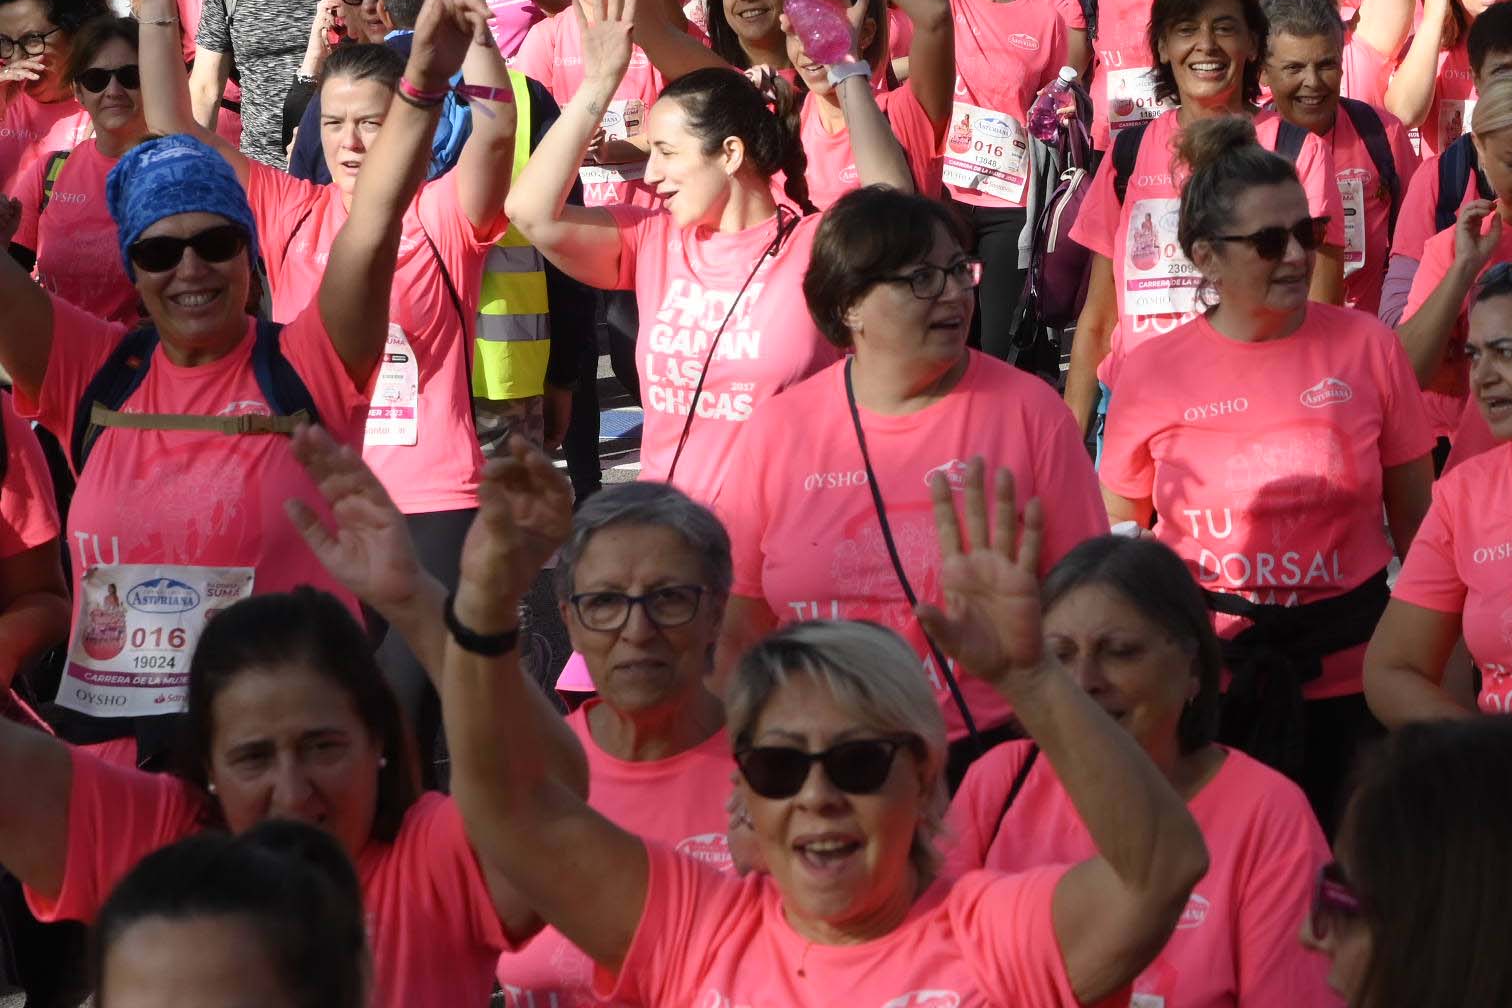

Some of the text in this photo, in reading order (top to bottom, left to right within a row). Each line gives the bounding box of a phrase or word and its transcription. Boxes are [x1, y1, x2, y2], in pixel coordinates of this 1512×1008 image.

[1101, 49, 1122, 67] TU
[974, 140, 1005, 157] 016
[948, 158, 972, 170] CARRERA
[1168, 263, 1194, 274] 2309
[1138, 278, 1192, 289] CARRERA DE LA
[1184, 397, 1249, 422] OYSHO
[803, 470, 869, 491] OYSHO
[1183, 507, 1233, 540] TU
[74, 531, 121, 569] TU
[1198, 547, 1345, 587] DORSAL
[131, 592, 194, 608] ASTURIANA
[206, 588, 241, 598] SUMA
[130, 626, 188, 649] 016
[132, 655, 177, 670] 19024
[84, 671, 190, 686] CARRERA DE LA MUJE
[75, 688, 128, 707] OYSHO
